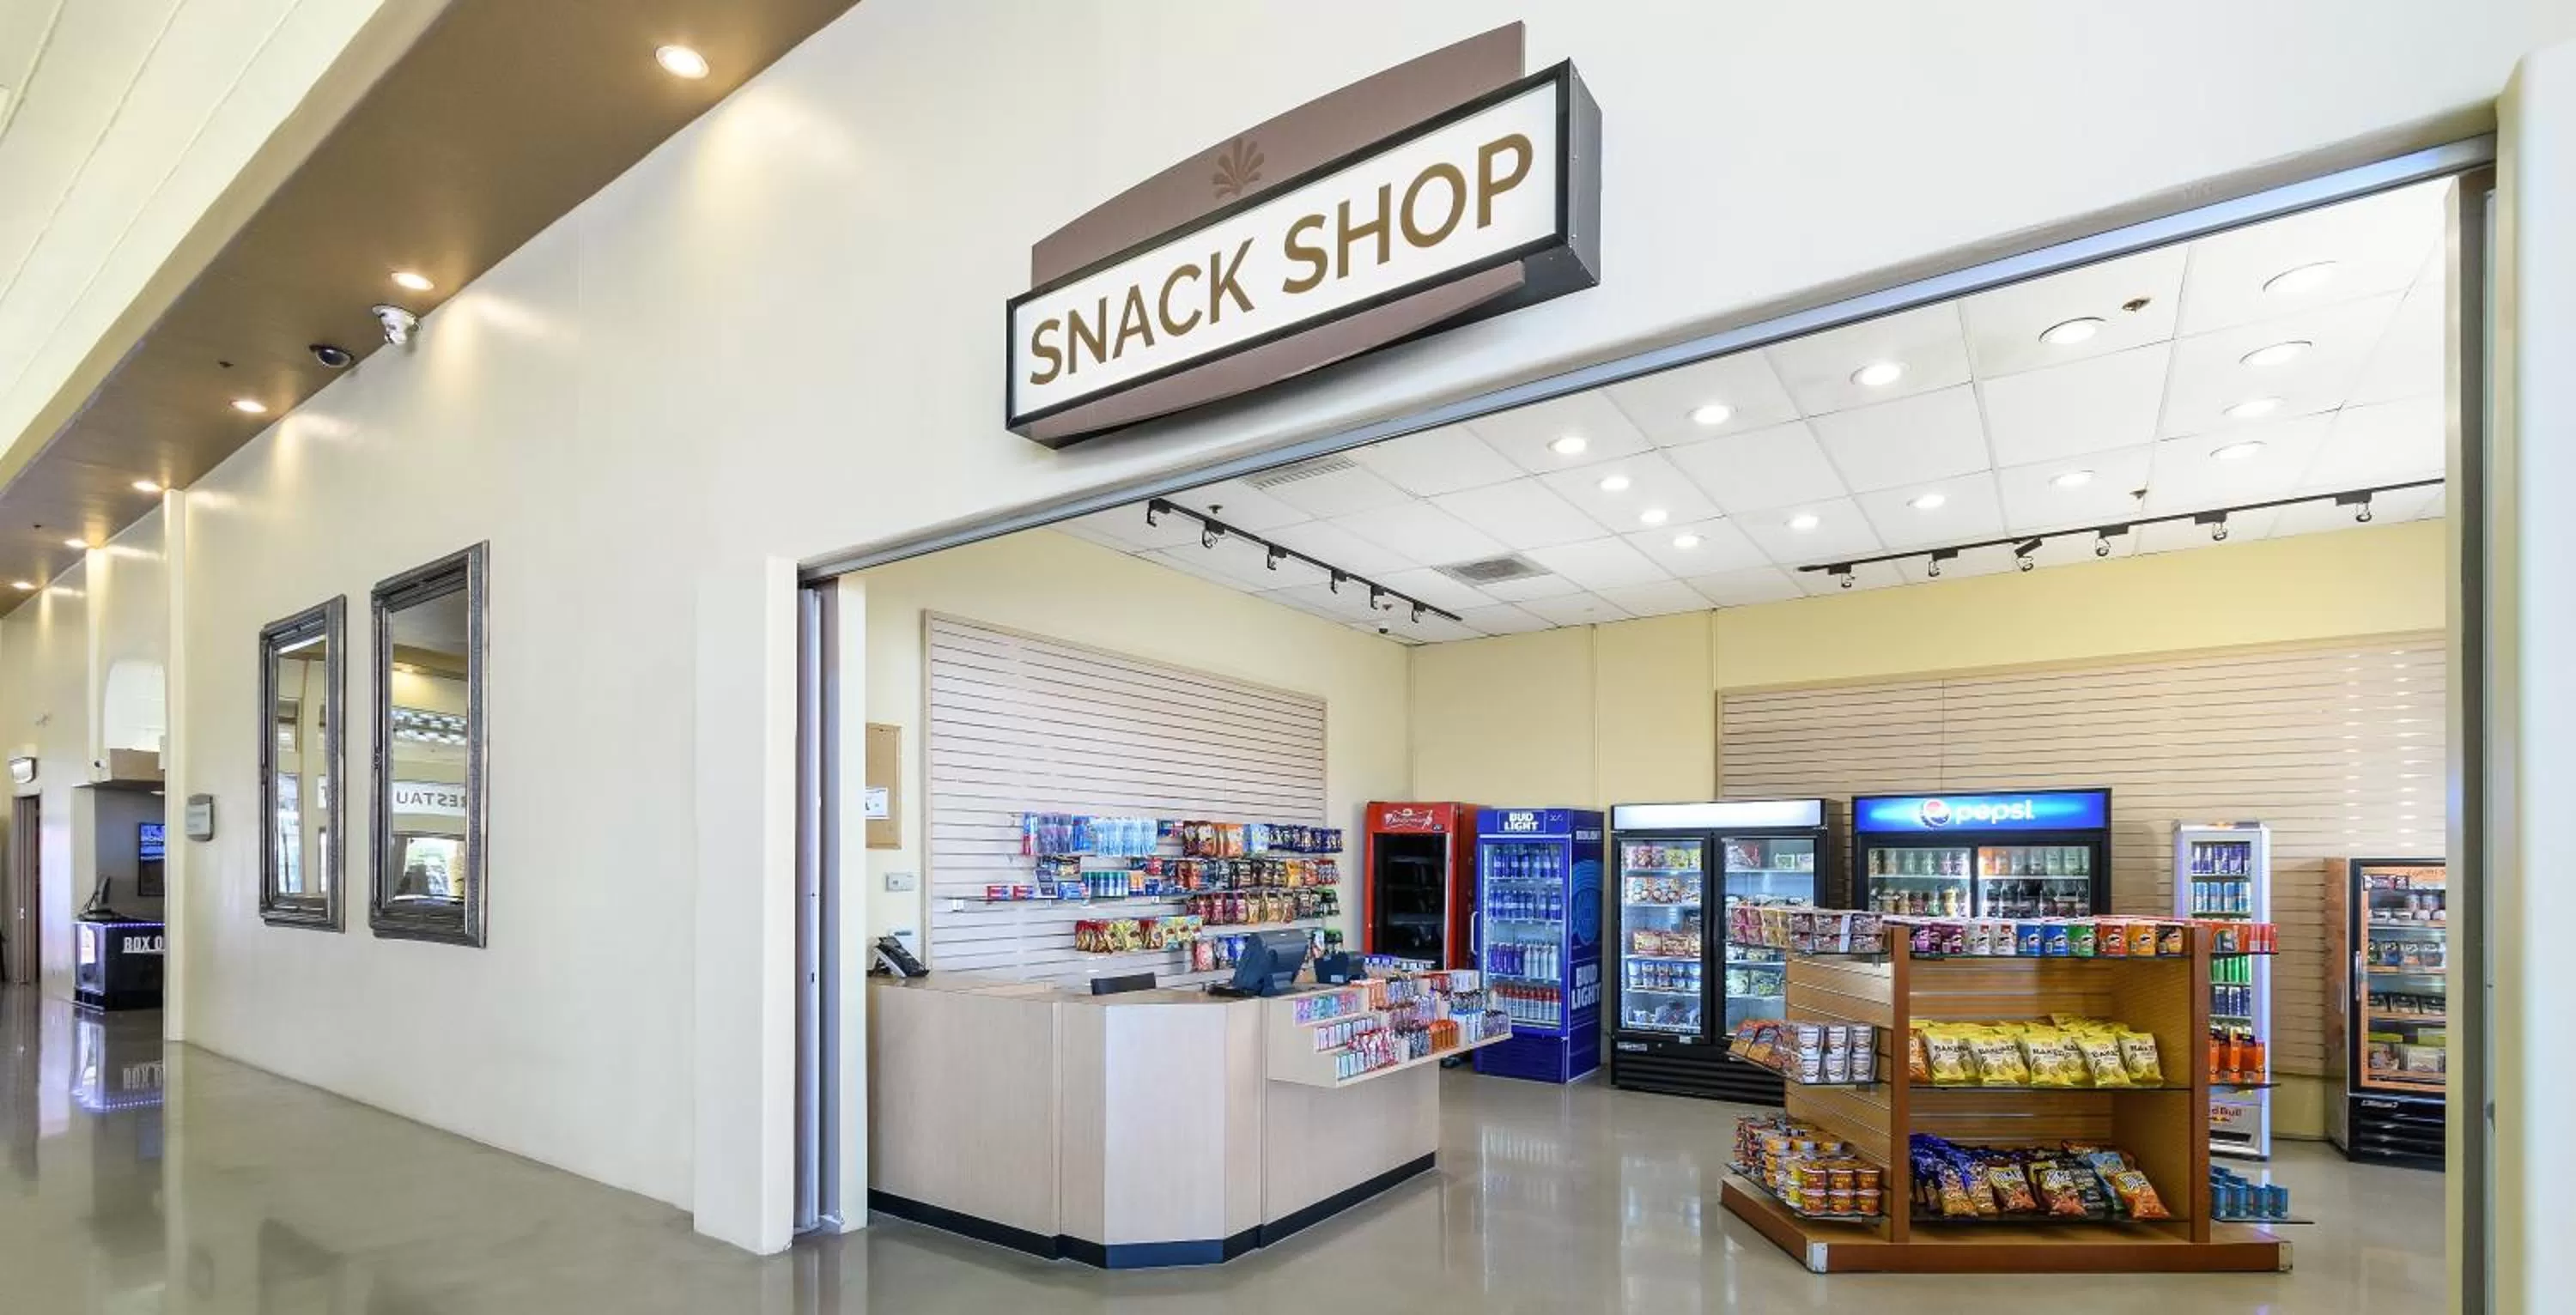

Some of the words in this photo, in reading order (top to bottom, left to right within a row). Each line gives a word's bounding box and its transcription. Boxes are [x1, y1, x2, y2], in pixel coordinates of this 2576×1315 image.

[1030, 238, 1255, 386] SNACK
[1282, 133, 1534, 294] SHOP
[1509, 812, 1534, 821] BUD
[1956, 799, 2032, 825] pepsi
[1504, 821, 1539, 831] LIGHT
[123, 936, 150, 952] BOX
[1571, 983, 1601, 1010] LIGHT
